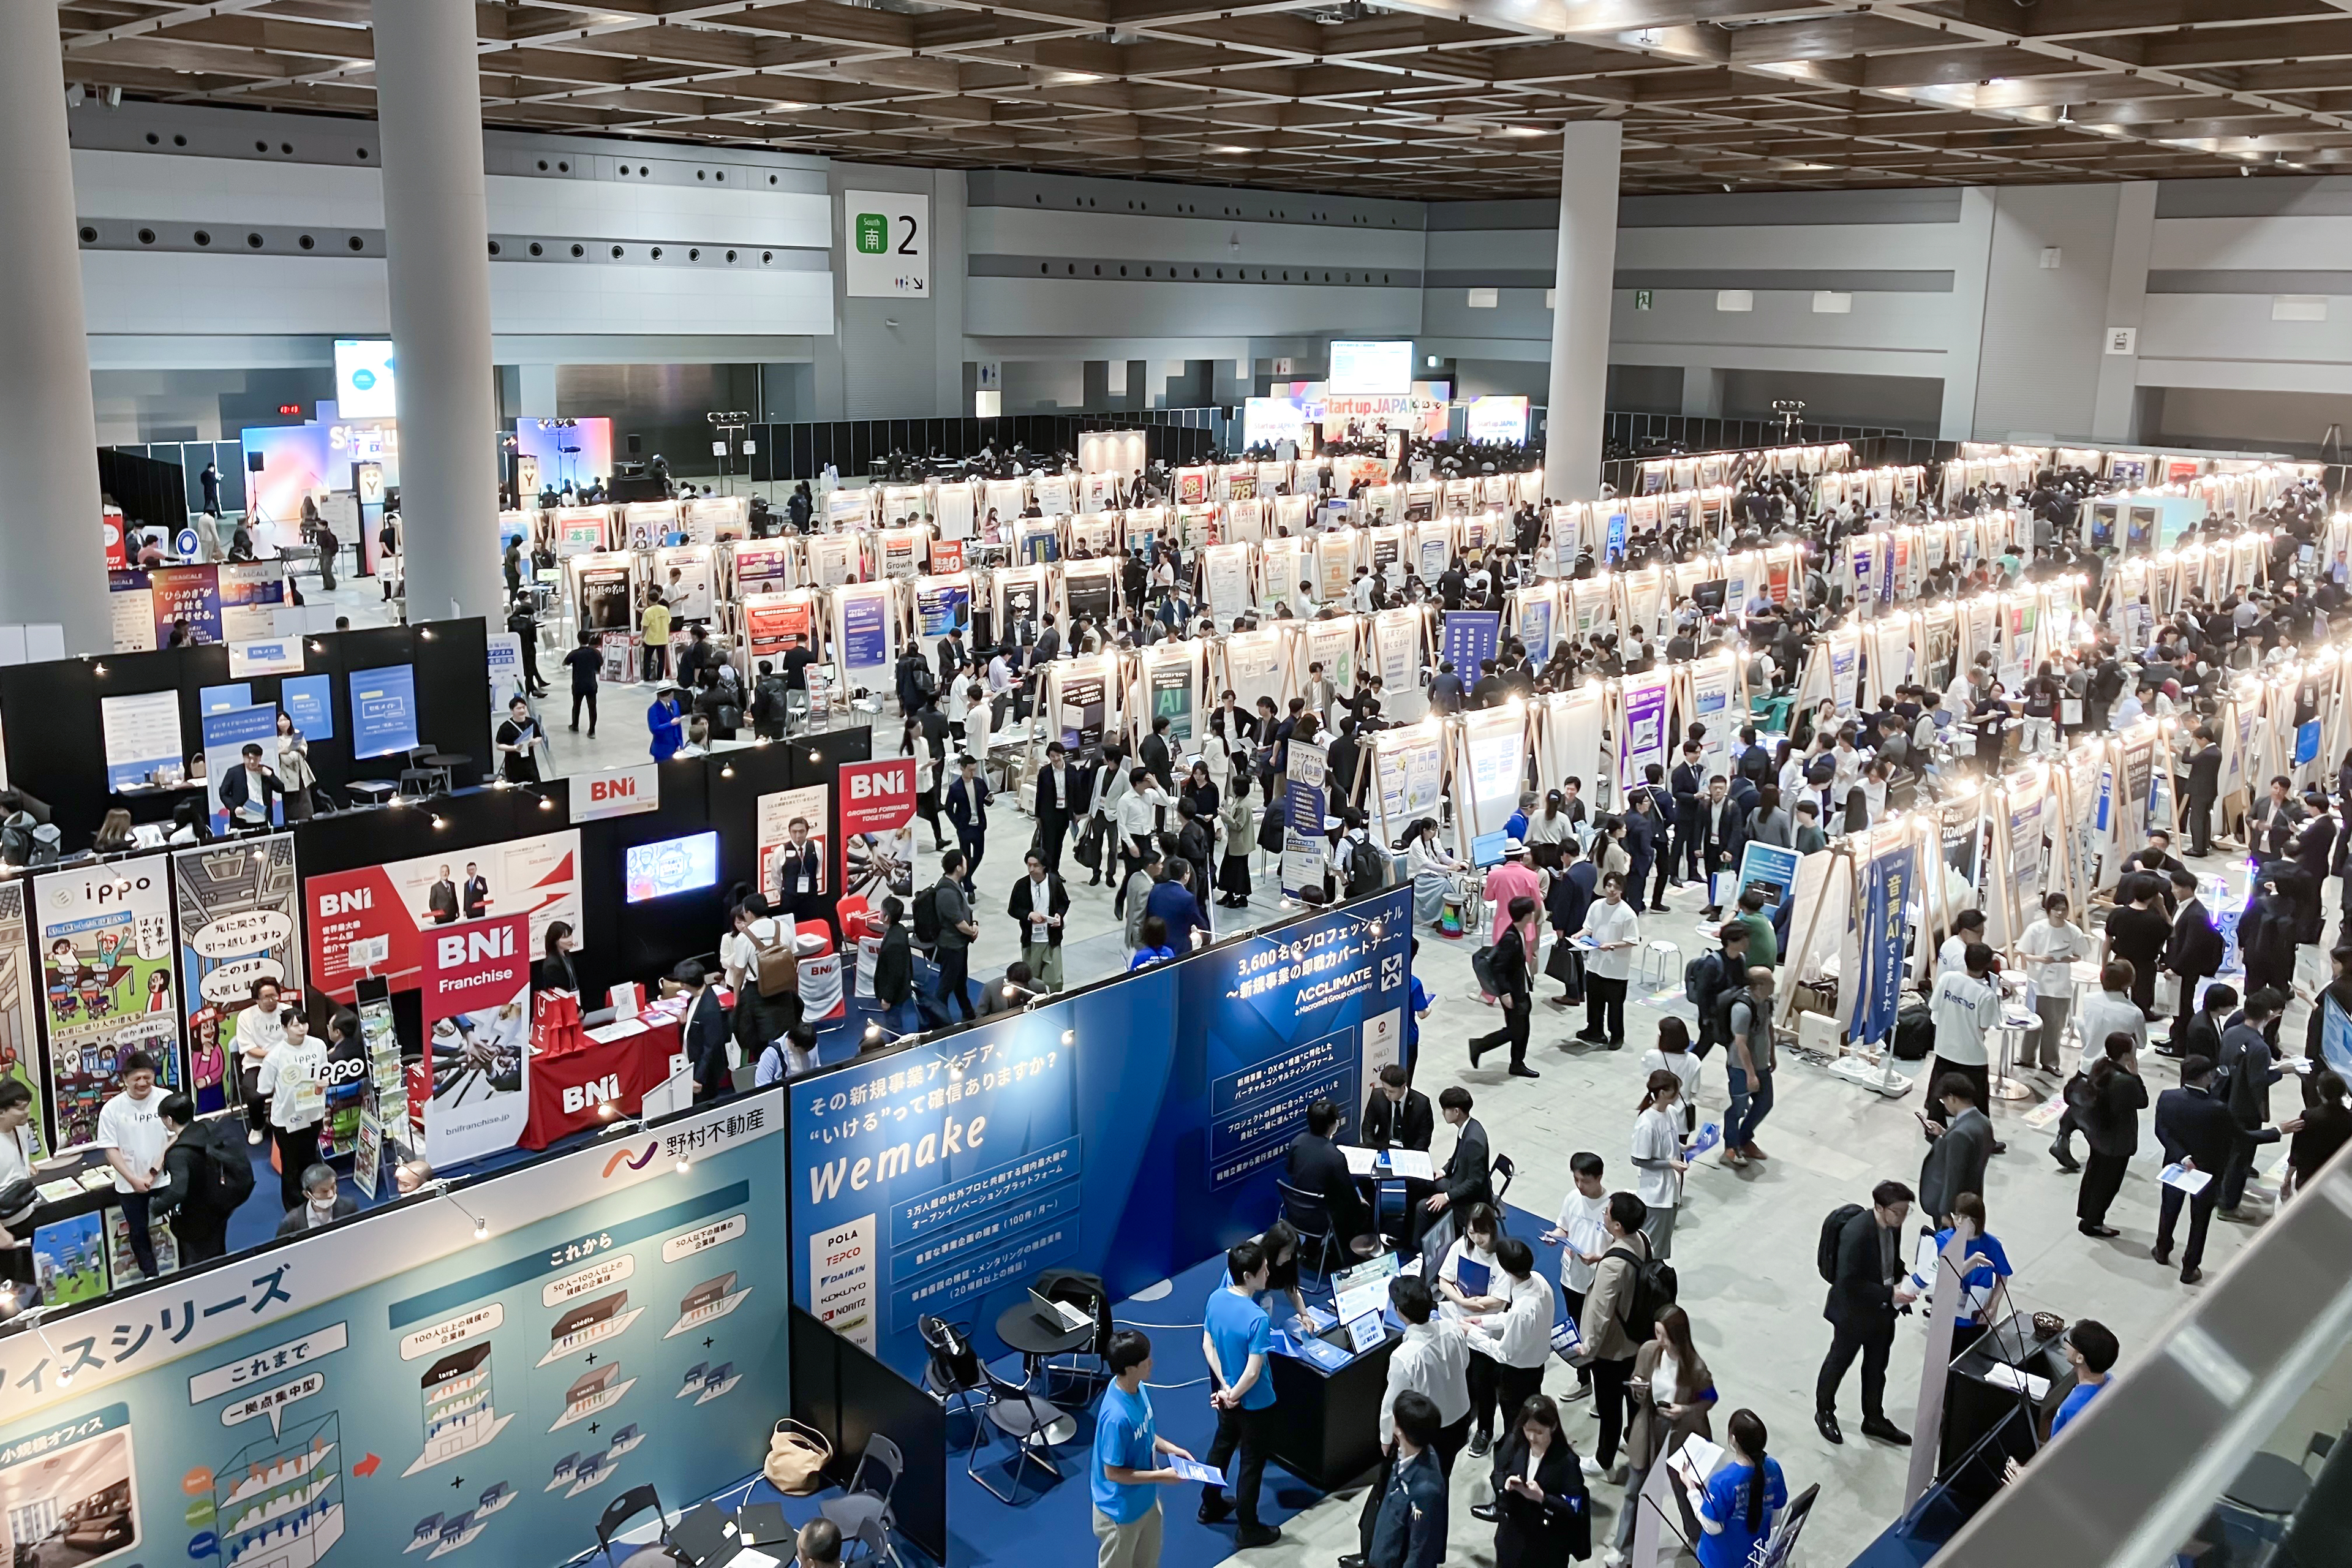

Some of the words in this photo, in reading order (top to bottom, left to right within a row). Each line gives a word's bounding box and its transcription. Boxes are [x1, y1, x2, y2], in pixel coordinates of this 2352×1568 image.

[864, 218, 880, 227] South
[865, 228, 879, 249] 南
[898, 215, 918, 255] 2
[1320, 398, 1354, 415] Start
[1355, 401, 1371, 416] up
[1373, 398, 1419, 413] JAPAN
[1304, 435, 1311, 445] X
[1389, 443, 1396, 453] X
[524, 473, 534, 487] Y
[1414, 472, 1422, 481] X
[367, 480, 378, 496] Y
[571, 529, 595, 542] 本音
[886, 559, 913, 570] Growth
[173, 599, 203, 611] 会社を
[1158, 689, 1182, 715] AI
[1291, 750, 1323, 763] バックオフィス
[1305, 764, 1322, 776] 診断
[591, 776, 635, 801] BNI
[851, 770, 904, 799] BNI
[846, 807, 878, 816] GROWING
[878, 803, 910, 813] FORWARD
[862, 812, 896, 822] TOGETHER
[85, 877, 151, 904] ippo
[320, 887, 372, 917] BNI
[215, 913, 270, 934] 元に戻さず
[437, 925, 514, 970] BNI
[219, 960, 263, 978] このまま
[811, 965, 832, 976] BNI
[439, 968, 513, 993] Franchise
[1295, 966, 1372, 1006] ACCLIMATE
[1299, 995, 1329, 1015] Macromill
[1329, 990, 1347, 1006] Group
[1346, 981, 1373, 1000] company
[265, 1023, 281, 1033] ipp
[294, 1053, 317, 1065] ippo
[1373, 1047, 1389, 1060] PARCO
[310, 1062, 361, 1082] ippo
[1235, 1053, 1334, 1100] バーチャルコンサルティングファーム
[563, 1074, 619, 1115] BNI
[446, 1114, 510, 1136] bnifranchise.jp
[666, 1108, 765, 1157] 野村不動産
[809, 1115, 986, 1205] Wemake
[911, 1166, 1063, 1230] オープンイノベーションプラットフォーム
[827, 1230, 858, 1248] POLA
[550, 1232, 612, 1267] これから
[826, 1246, 861, 1267] TEPCO
[830, 1264, 866, 1283] DAIKIN
[821, 1282, 866, 1305] KOKUYO
[835, 1298, 866, 1316] NORITZ
[0, 1262, 292, 1395] ィスシリーズ
[570, 1316, 594, 1330] middle
[231, 1342, 311, 1384] これまで
[438, 1367, 459, 1380] large
[0, 1416, 104, 1464] 小規模オフィス
